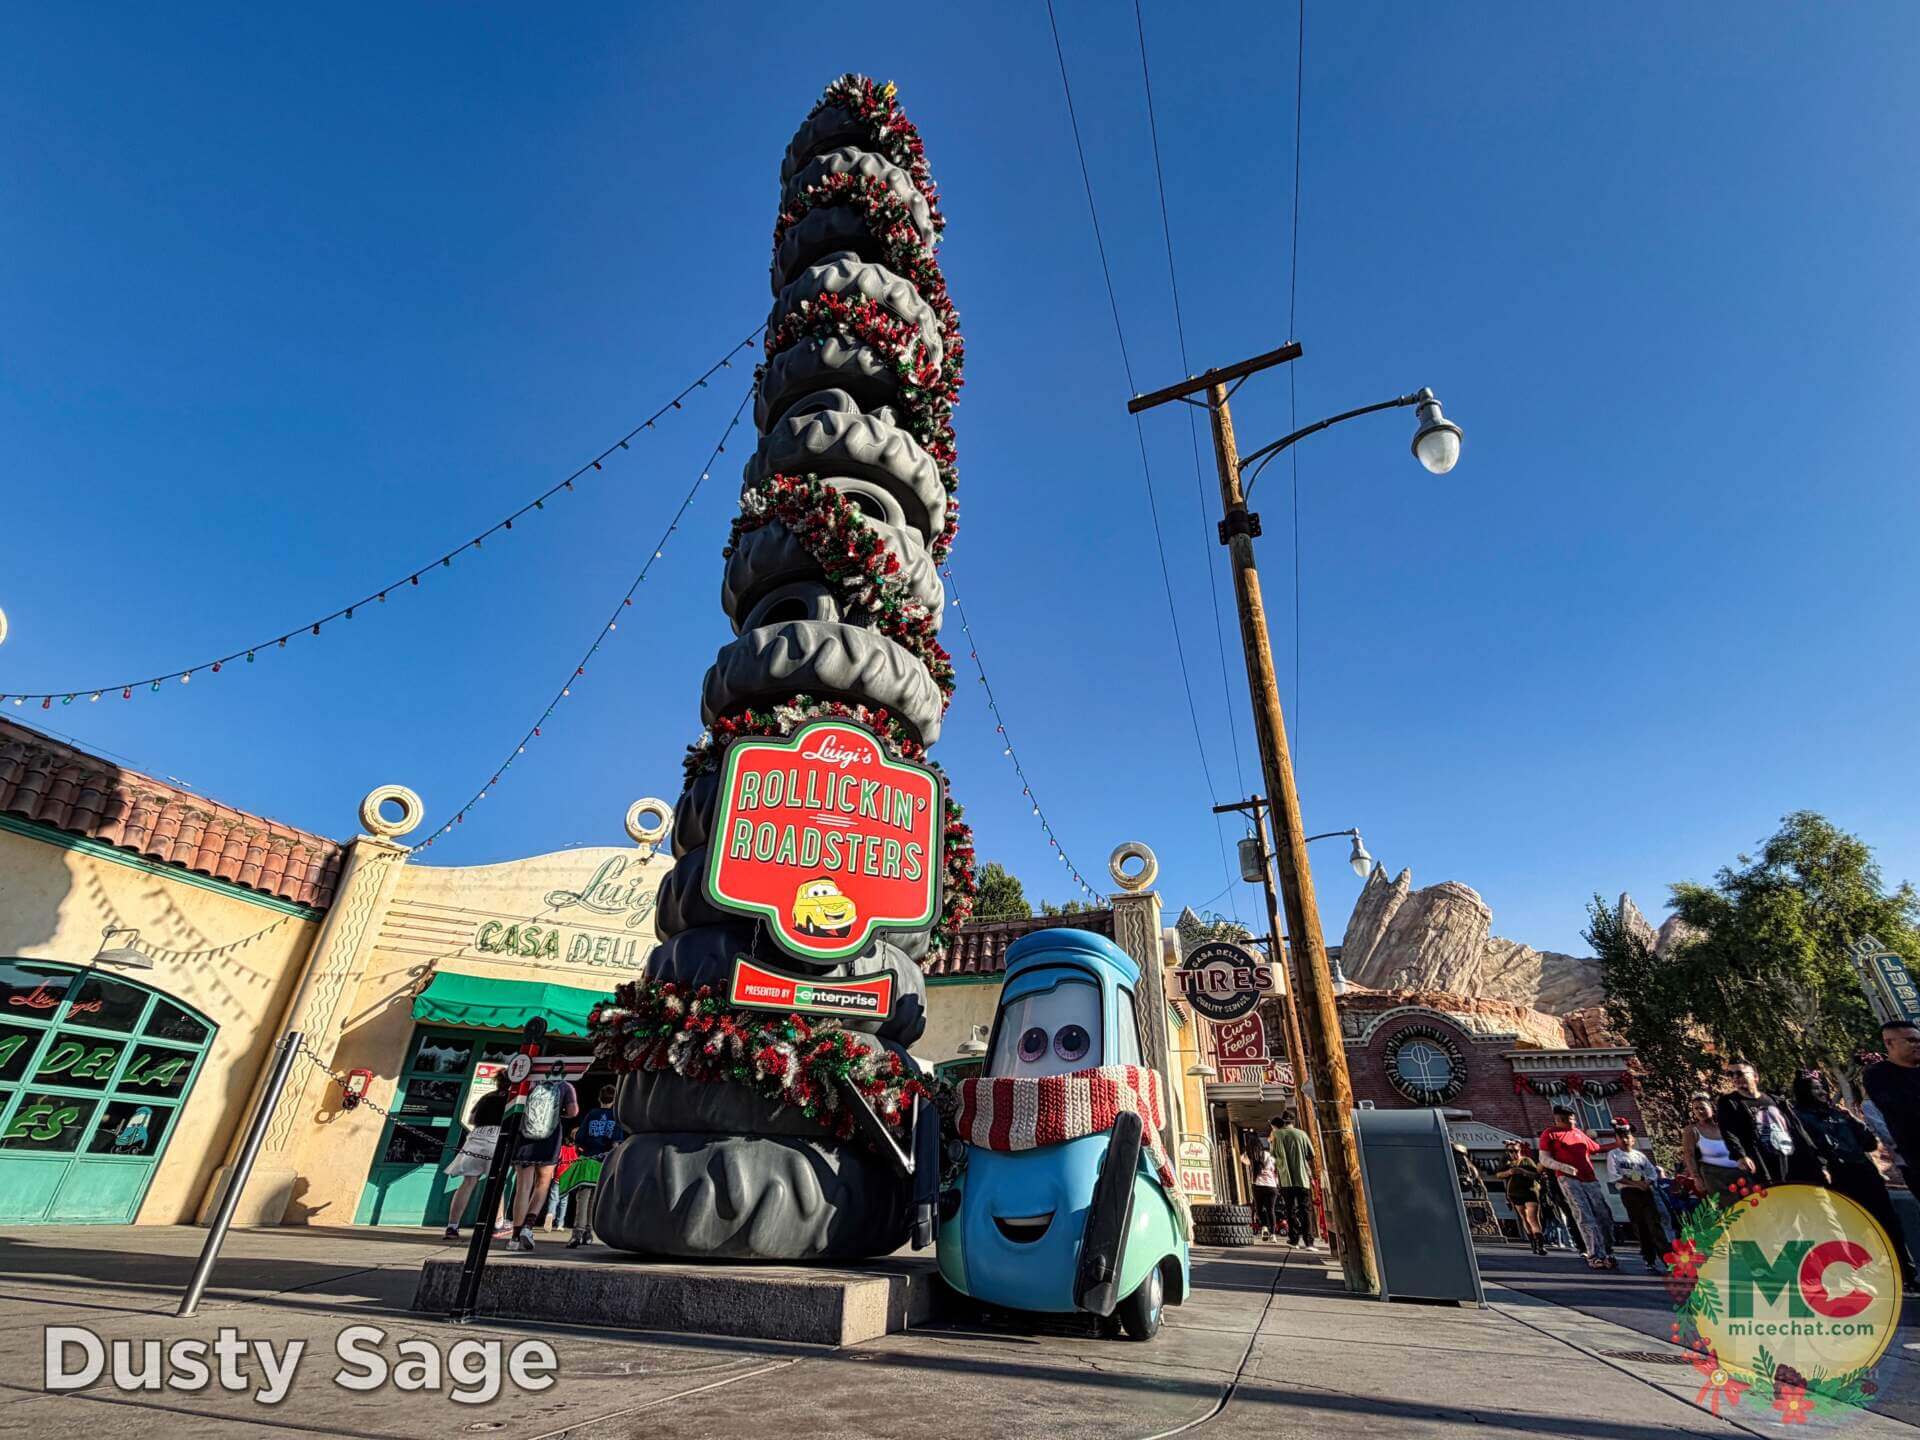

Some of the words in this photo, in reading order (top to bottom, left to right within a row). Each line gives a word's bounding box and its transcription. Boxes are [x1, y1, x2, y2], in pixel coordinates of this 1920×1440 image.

[801, 734, 873, 769] Luigi's
[737, 769, 927, 832] ROLLICKIN'
[729, 818, 924, 881] ROADSTERS
[544, 854, 657, 928] Luig
[474, 920, 560, 960] CASA
[1191, 950, 1214, 968] CASA
[1216, 948, 1245, 966] DELLA
[744, 985, 780, 998] PRESENTED
[781, 988, 791, 998] BY
[1175, 966, 1275, 995] TIRES
[1881, 958, 1920, 1014] LUBE
[799, 990, 878, 1007] enterprise
[1196, 996, 1223, 1013] QUALITY
[1221, 1018, 1253, 1040] Curb
[1222, 1030, 1258, 1057] Feeler
[37, 1041, 187, 1087] DELLA
[1449, 1132, 1500, 1143] SPRINGS
[1183, 1170, 1210, 1191] SALE
